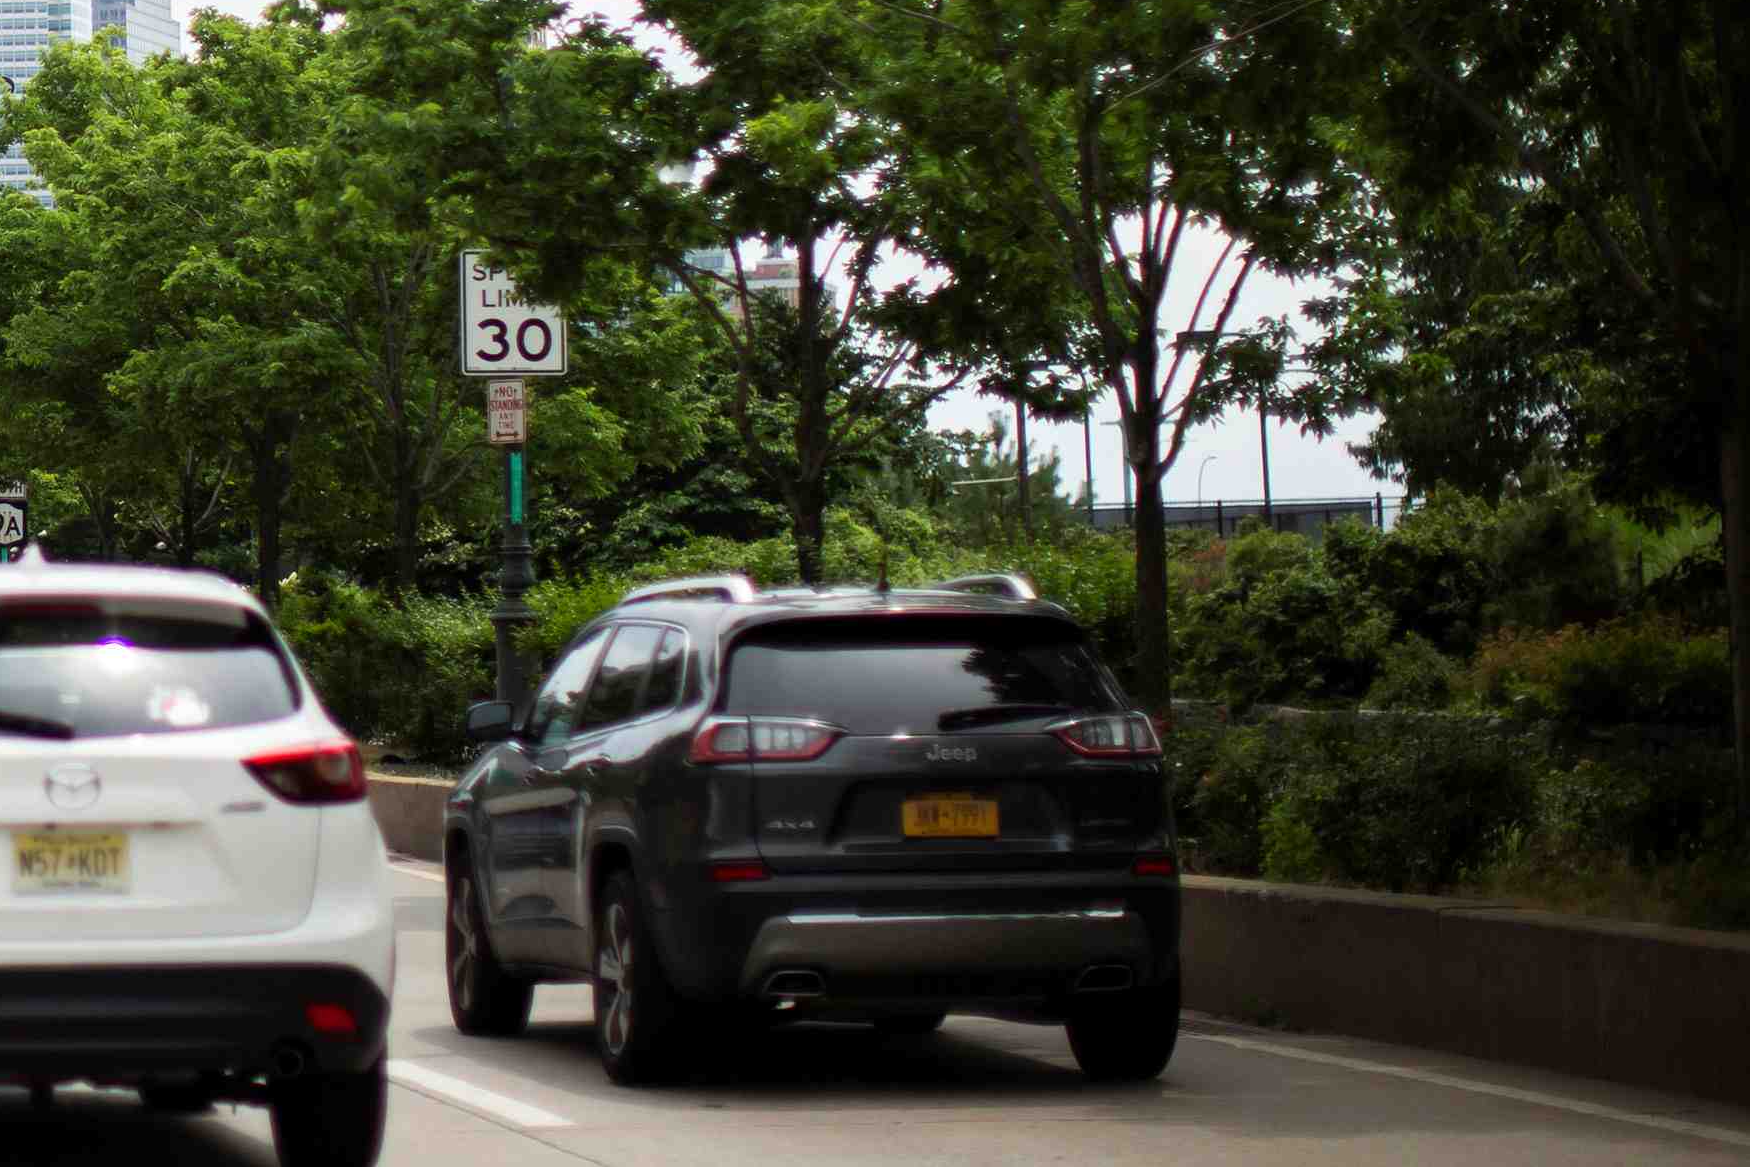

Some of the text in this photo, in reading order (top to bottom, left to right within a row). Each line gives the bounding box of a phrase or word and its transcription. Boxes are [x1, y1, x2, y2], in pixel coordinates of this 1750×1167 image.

[476, 318, 552, 362] 30
[499, 386, 514, 397] NO
[924, 744, 978, 762] Jeep
